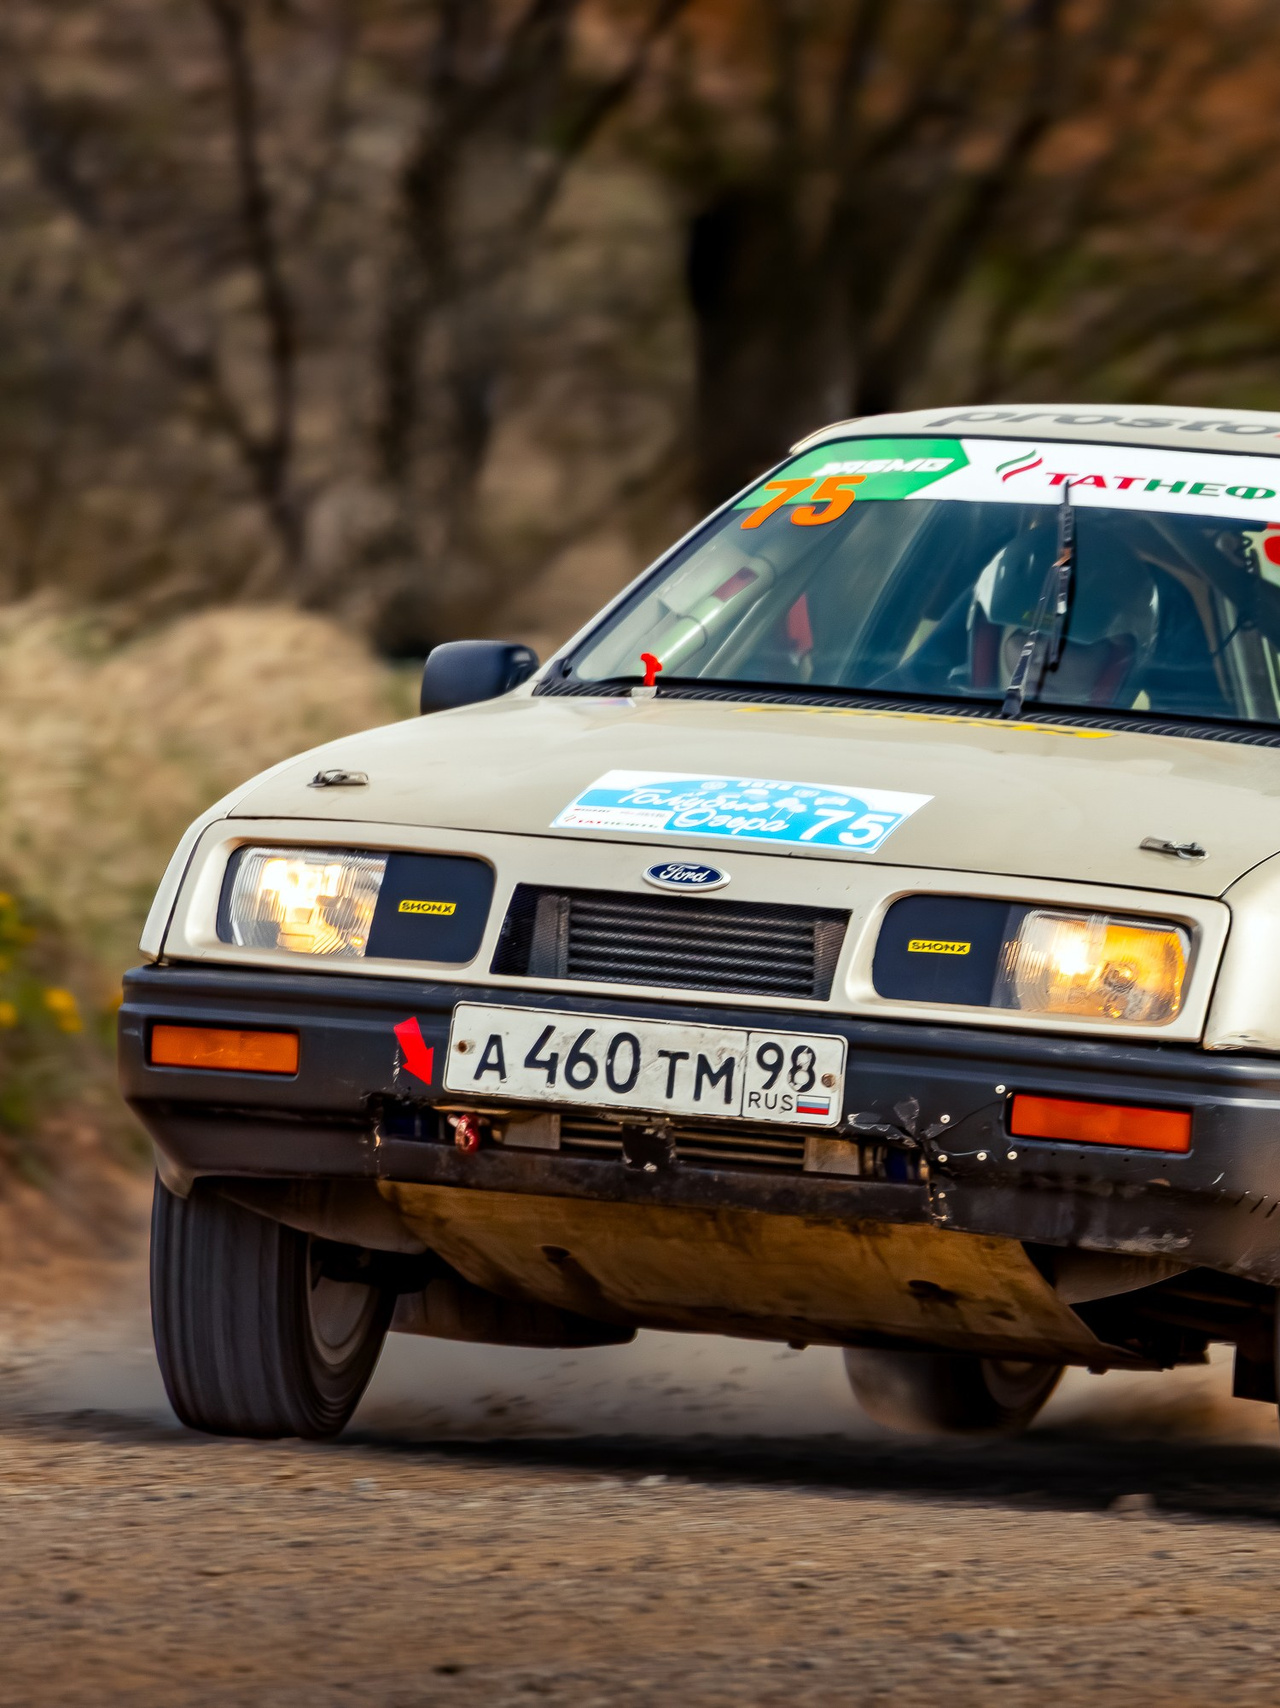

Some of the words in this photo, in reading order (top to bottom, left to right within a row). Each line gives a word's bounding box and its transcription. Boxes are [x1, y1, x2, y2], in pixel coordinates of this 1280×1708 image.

[740, 475, 867, 530] 75
[673, 808, 790, 836] Озера
[799, 808, 897, 846] 75
[659, 864, 711, 883] Ford
[402, 902, 452, 913] SHONX
[912, 941, 967, 952] SHONX
[524, 1025, 641, 1094] 460
[756, 1041, 817, 1093] 98
[748, 1092, 793, 1114] RUS
